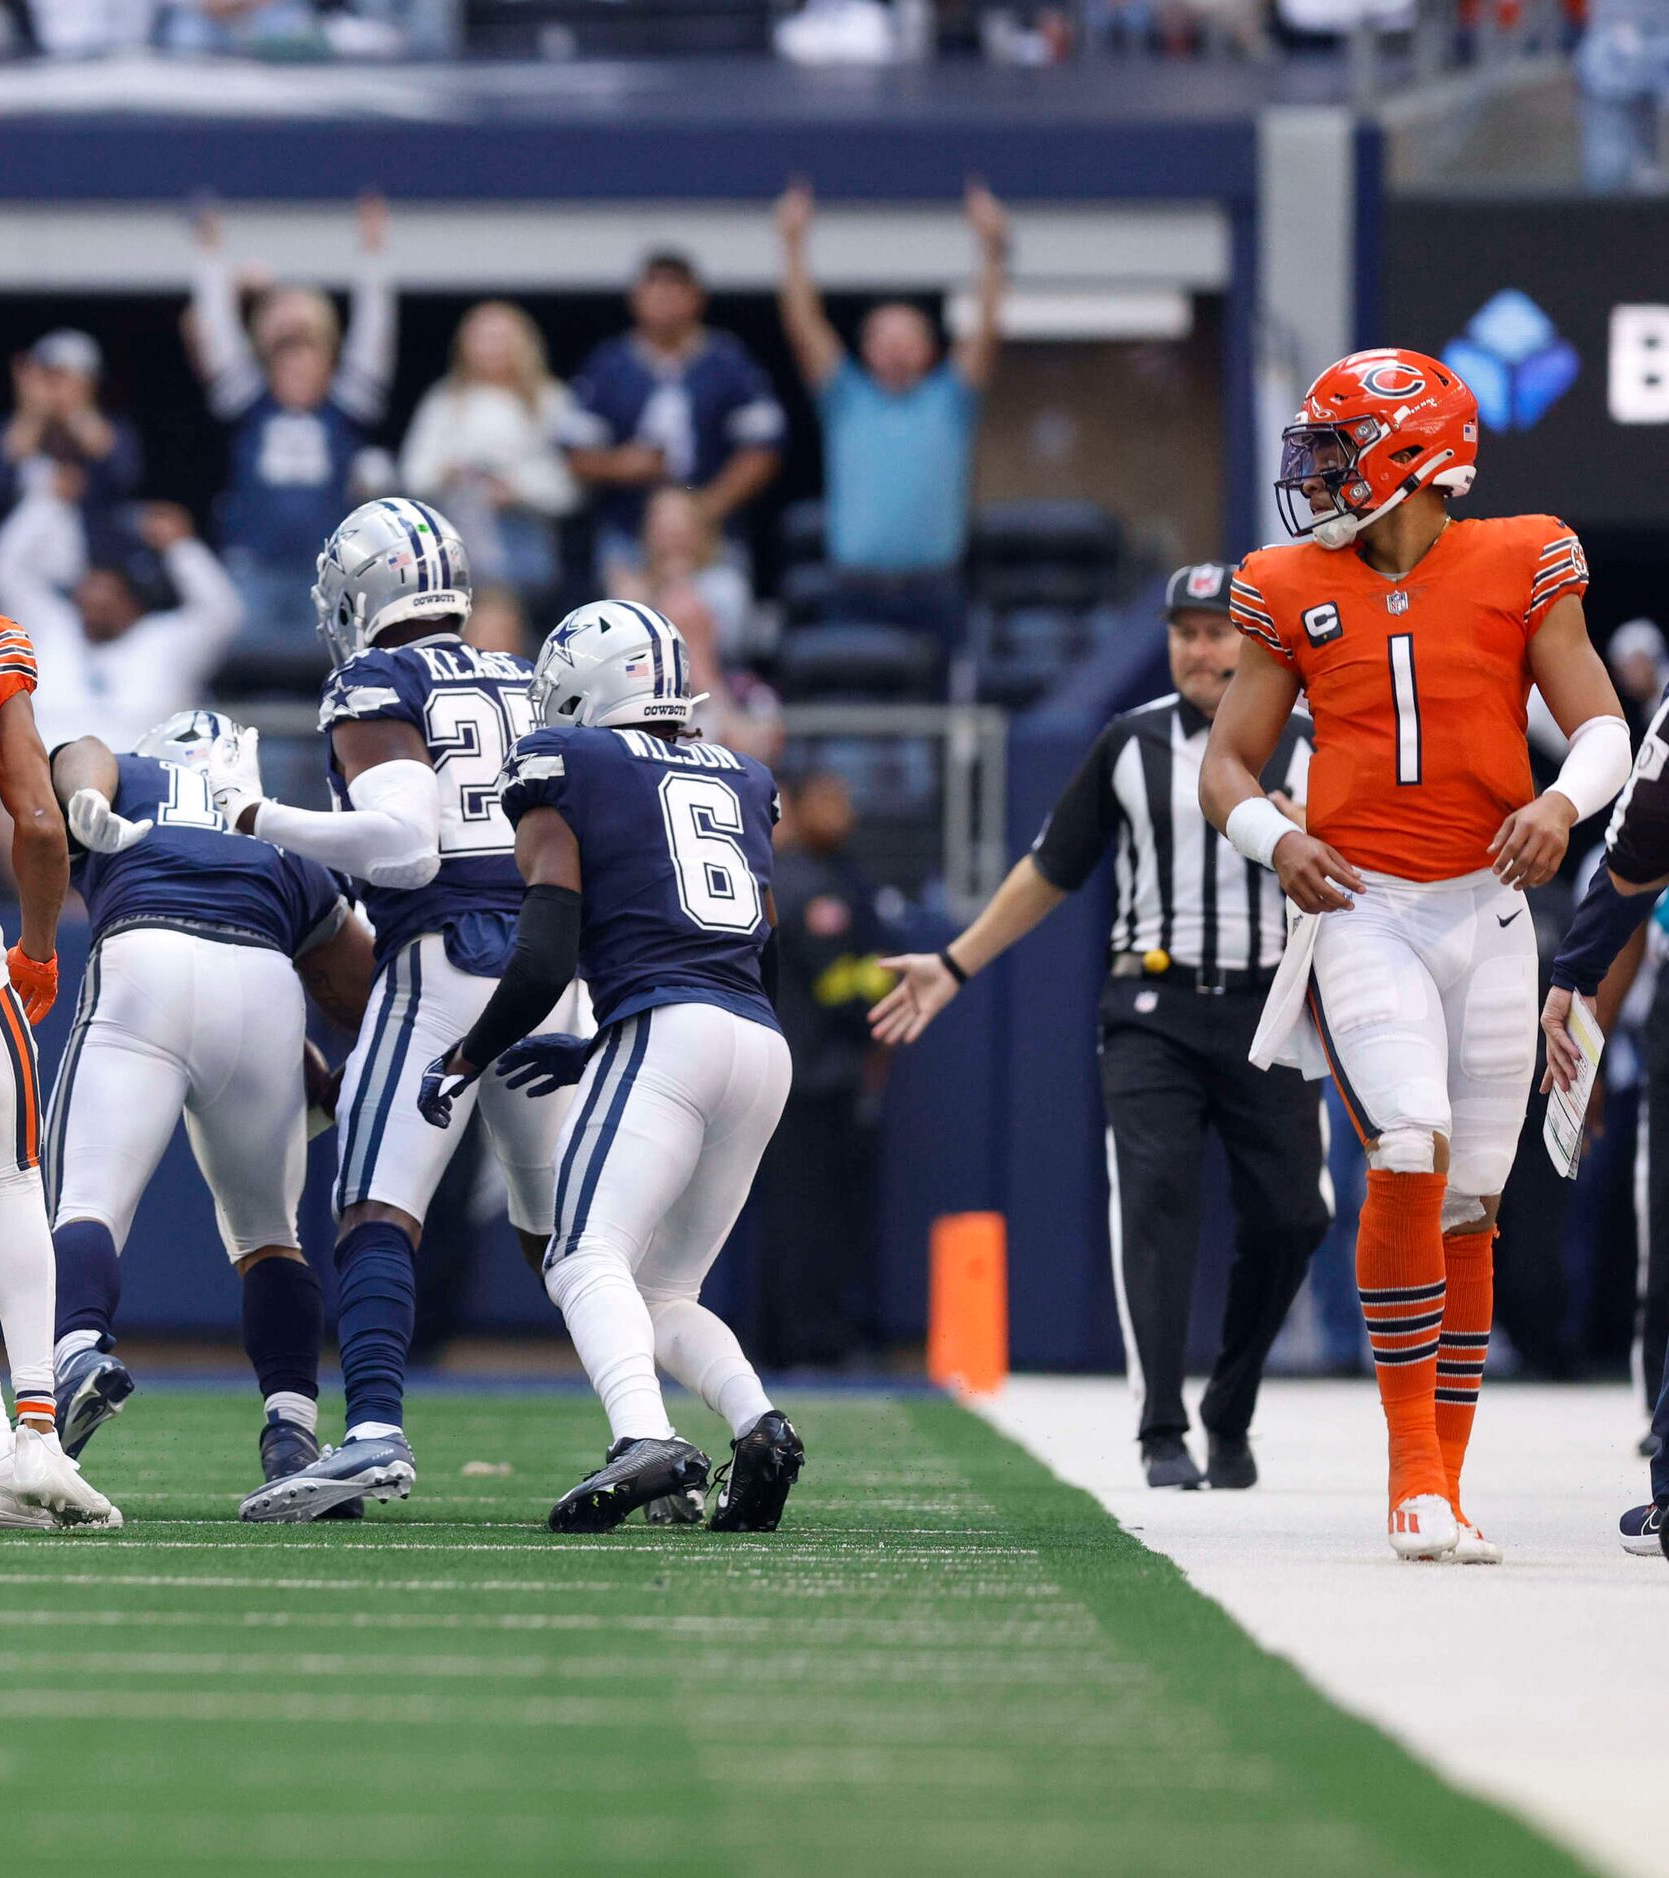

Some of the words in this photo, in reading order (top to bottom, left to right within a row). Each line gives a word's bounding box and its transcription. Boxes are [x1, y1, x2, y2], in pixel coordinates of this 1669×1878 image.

[1304, 604, 1338, 637] C
[611, 728, 746, 770] WILSON
[1387, 633, 1422, 786] 1
[658, 771, 763, 935] 6
